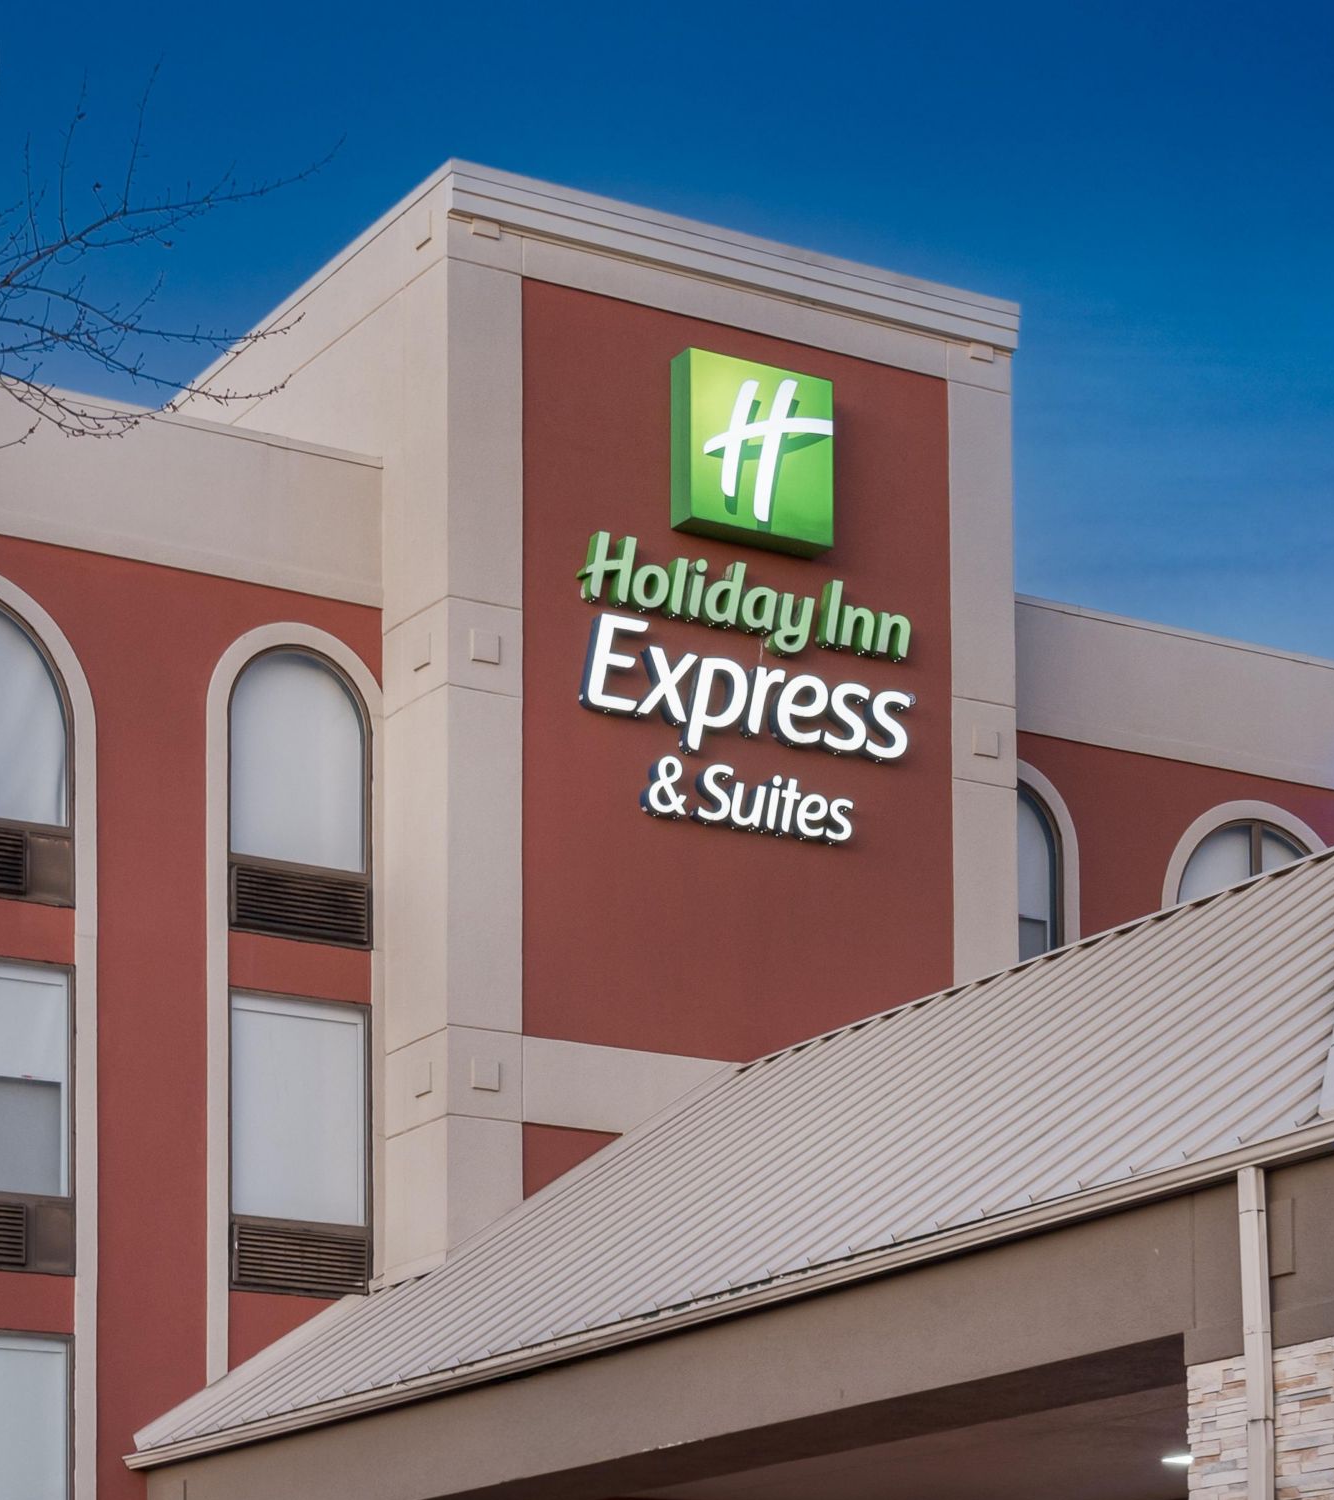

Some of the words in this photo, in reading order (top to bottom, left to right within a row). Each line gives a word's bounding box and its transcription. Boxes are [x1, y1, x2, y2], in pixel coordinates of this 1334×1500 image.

[577, 531, 814, 656] Holiday
[816, 579, 912, 661] Inn
[582, 612, 912, 759] Express
[646, 755, 687, 815] &
[697, 763, 855, 842] Suites
